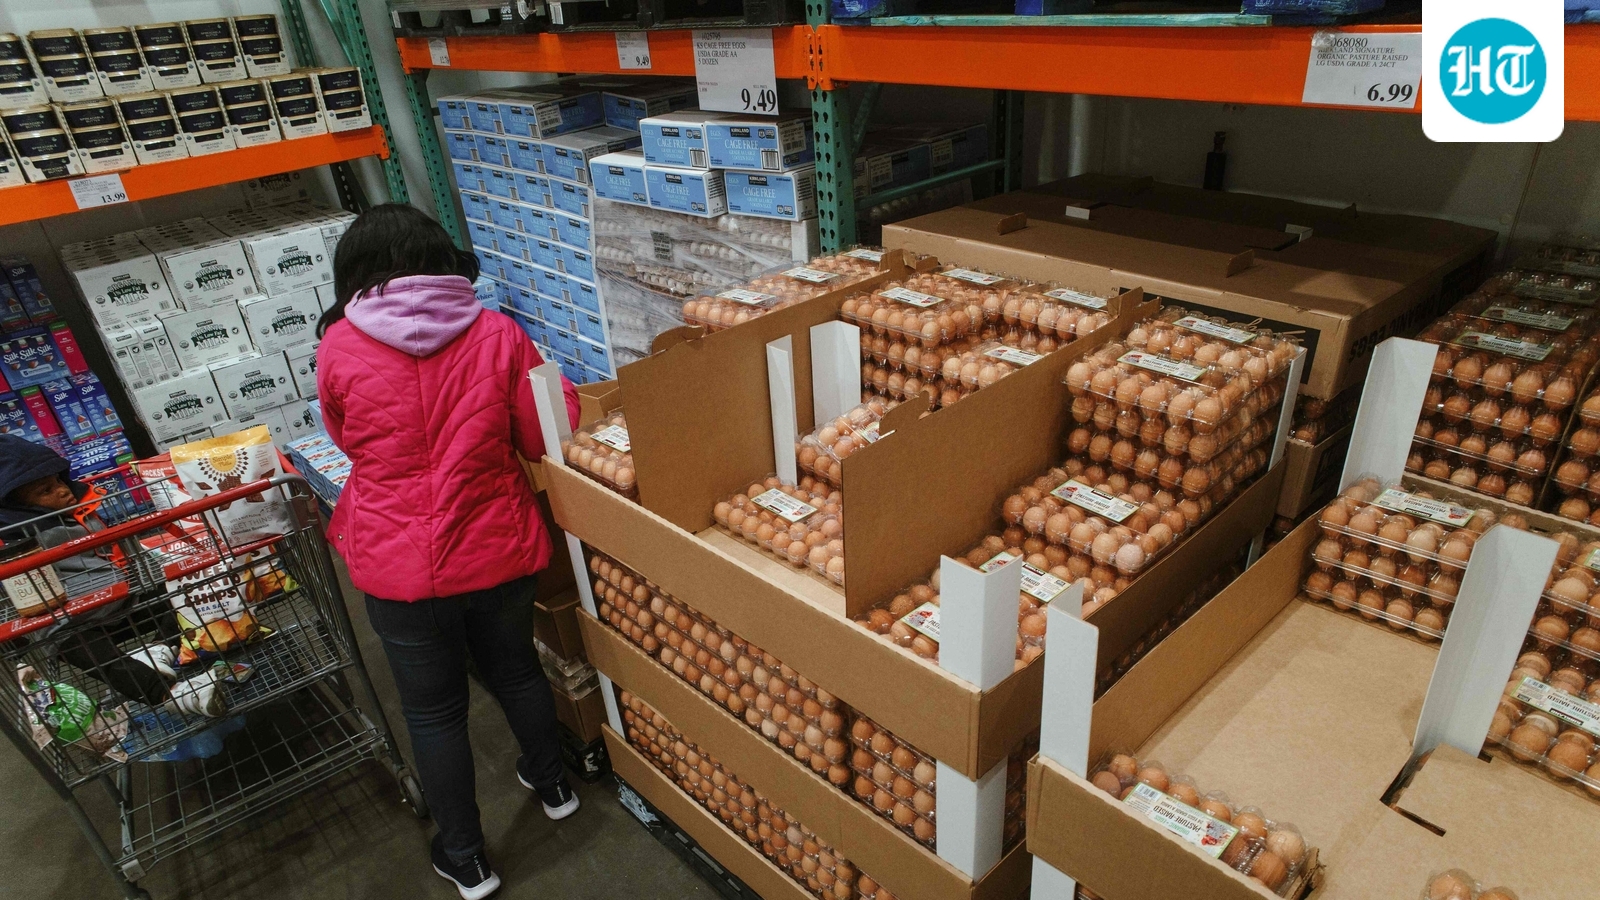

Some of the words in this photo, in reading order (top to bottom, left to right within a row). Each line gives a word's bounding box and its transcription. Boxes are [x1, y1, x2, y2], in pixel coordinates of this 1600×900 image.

[635, 55, 650, 66] 9.49
[1367, 82, 1412, 102] 6.99
[741, 88, 776, 112] 9.49
[657, 138, 672, 147] CAGE
[674, 139, 687, 148] FREE
[725, 140, 742, 149] CAGE
[743, 140, 759, 149] FREE
[605, 176, 618, 185] CAGE
[619, 178, 631, 186] FREE
[662, 184, 677, 194] CAGE
[678, 186, 690, 195] FREE
[743, 187, 759, 197] CAGE
[761, 189, 776, 198] FREE
[101, 192, 126, 203] 13.99
[278, 251, 308, 263] ORGANIC
[12, 267, 26, 276] Silk
[195, 265, 228, 277] ORGANIC
[283, 262, 313, 277] MILK
[107, 279, 142, 292] ORGANIC
[201, 275, 233, 291] MILK
[114, 289, 149, 305] MILK
[272, 311, 302, 324] ORGANIC
[191, 324, 223, 337] ORGANIC
[277, 322, 306, 336] MILK
[197, 335, 229, 350] MILK
[4, 352, 19, 364] Silk
[19, 347, 38, 360] Silk
[37, 344, 53, 356] Silk
[240, 374, 271, 387] ORGANIC
[82, 385, 96, 395] Silk
[246, 386, 275, 400] MILK
[54, 392, 68, 403] Silk
[164, 394, 197, 407] ORGANIC
[8, 410, 25, 421] Silk
[171, 406, 203, 421] MILK
[196, 605, 211, 613] SEA
[212, 601, 230, 609] SALT
[1160, 801, 1172, 810] LARGE
[1153, 805, 1201, 832] PASTURE-RAISED
[1175, 808, 1187, 817] GRADE
[1169, 821, 1190, 835] ORGANIC
